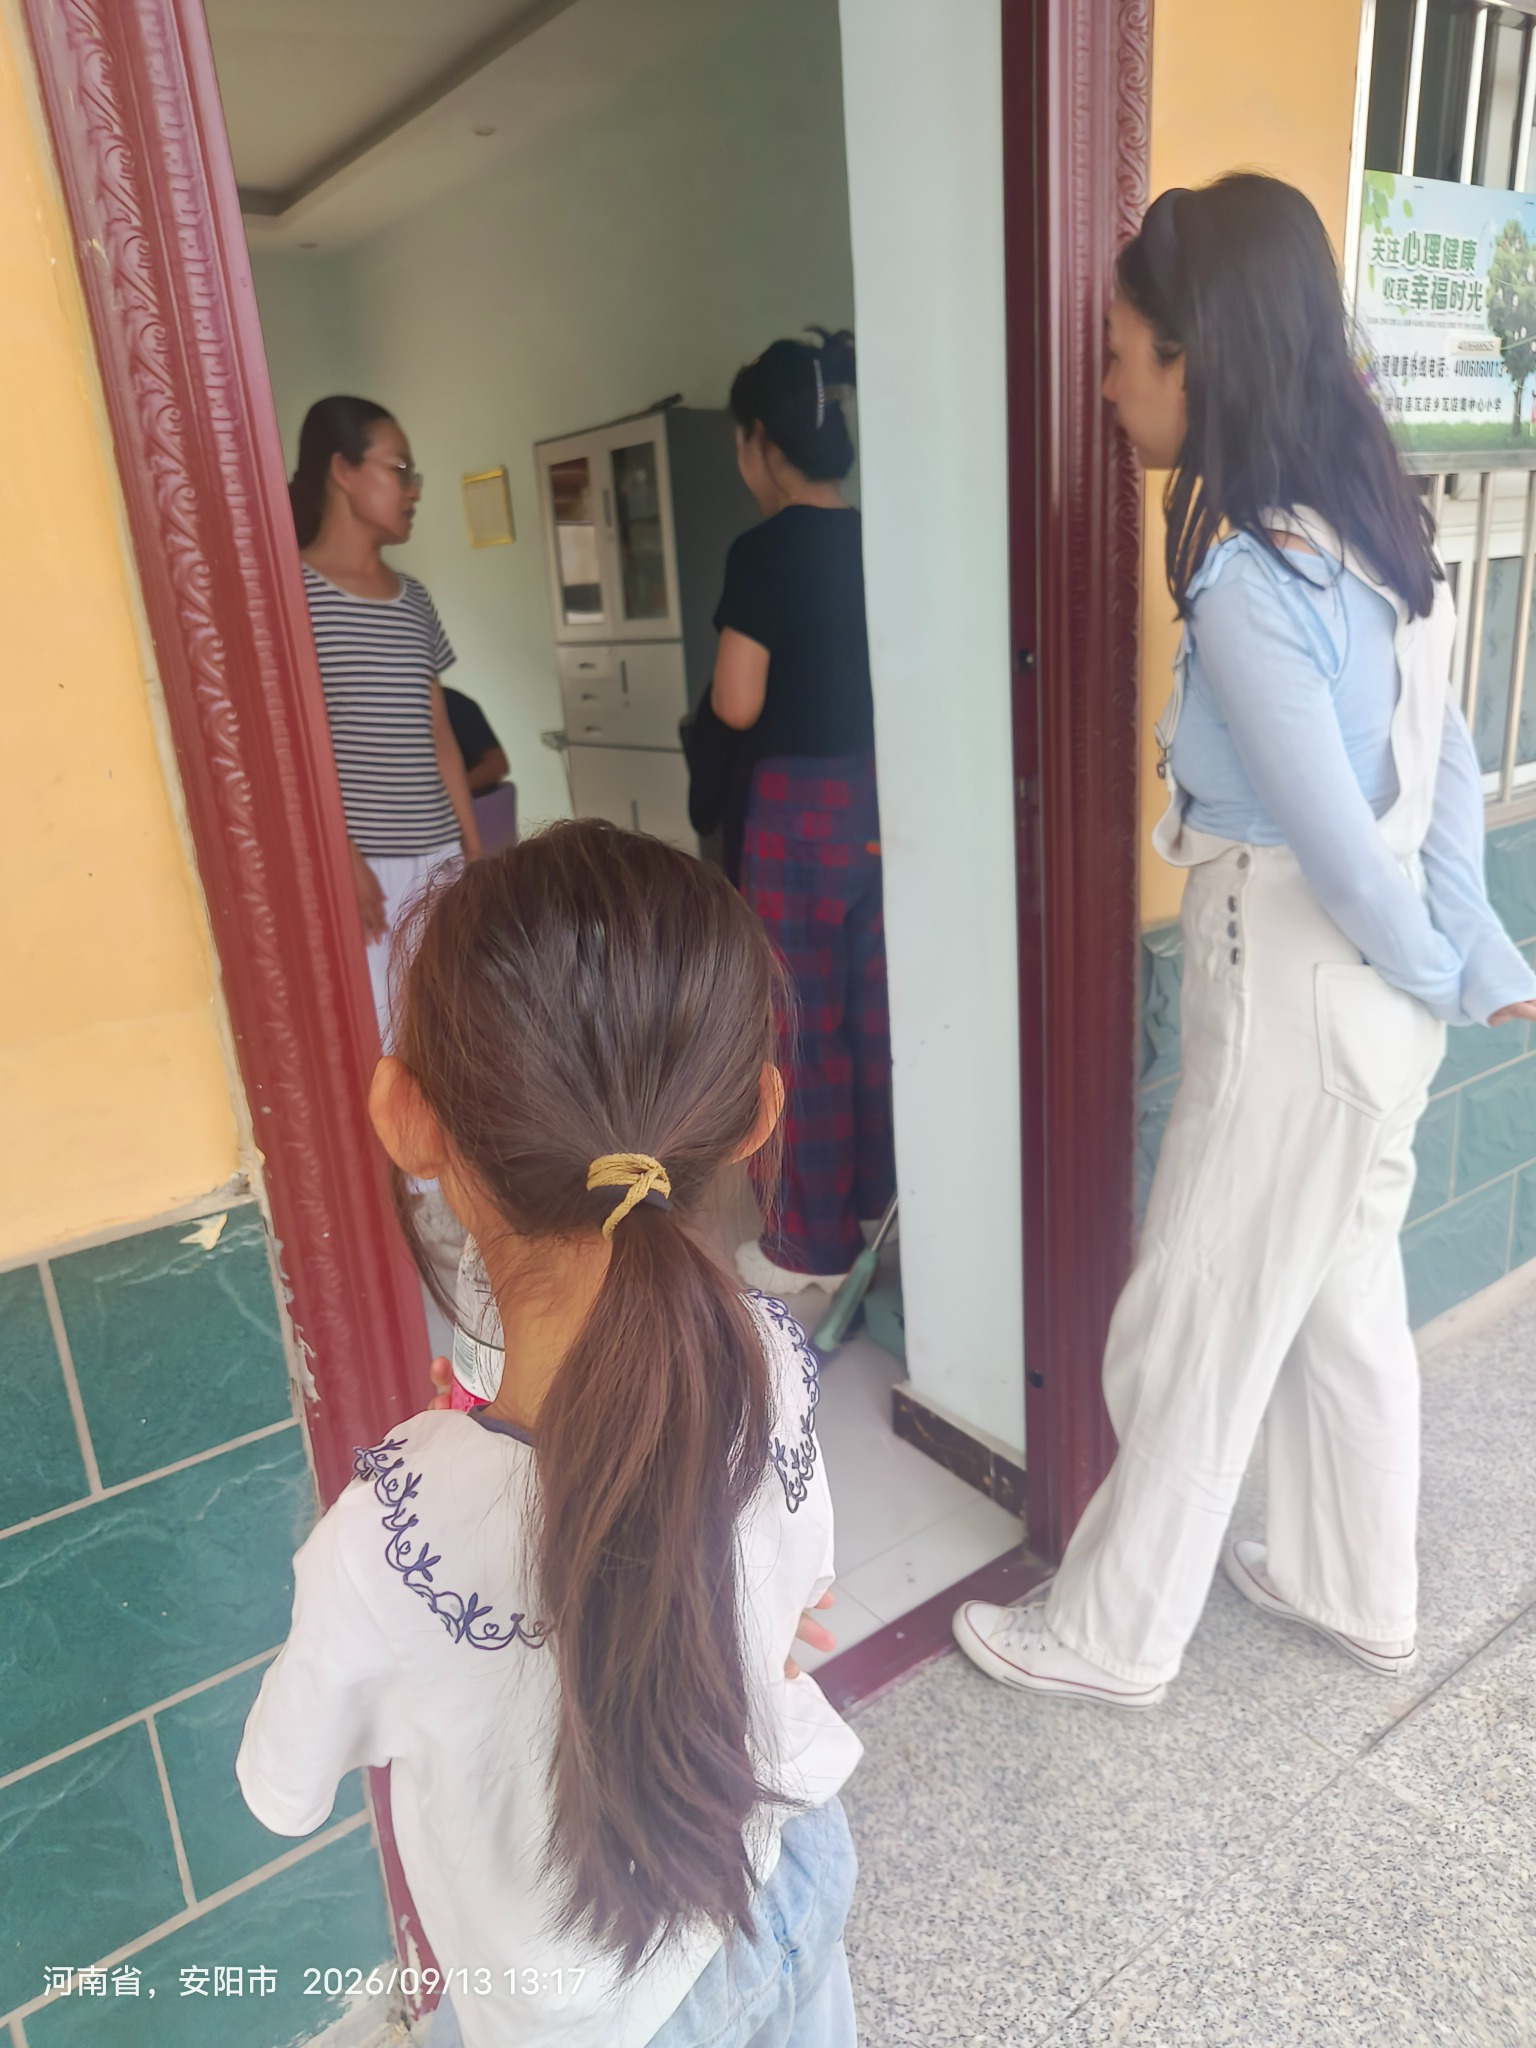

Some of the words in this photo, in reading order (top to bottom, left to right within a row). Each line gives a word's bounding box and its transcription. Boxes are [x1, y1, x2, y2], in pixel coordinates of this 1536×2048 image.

[1371, 231, 1478, 272] 关注心理健康
[1382, 274, 1483, 312] 收获幸福时光
